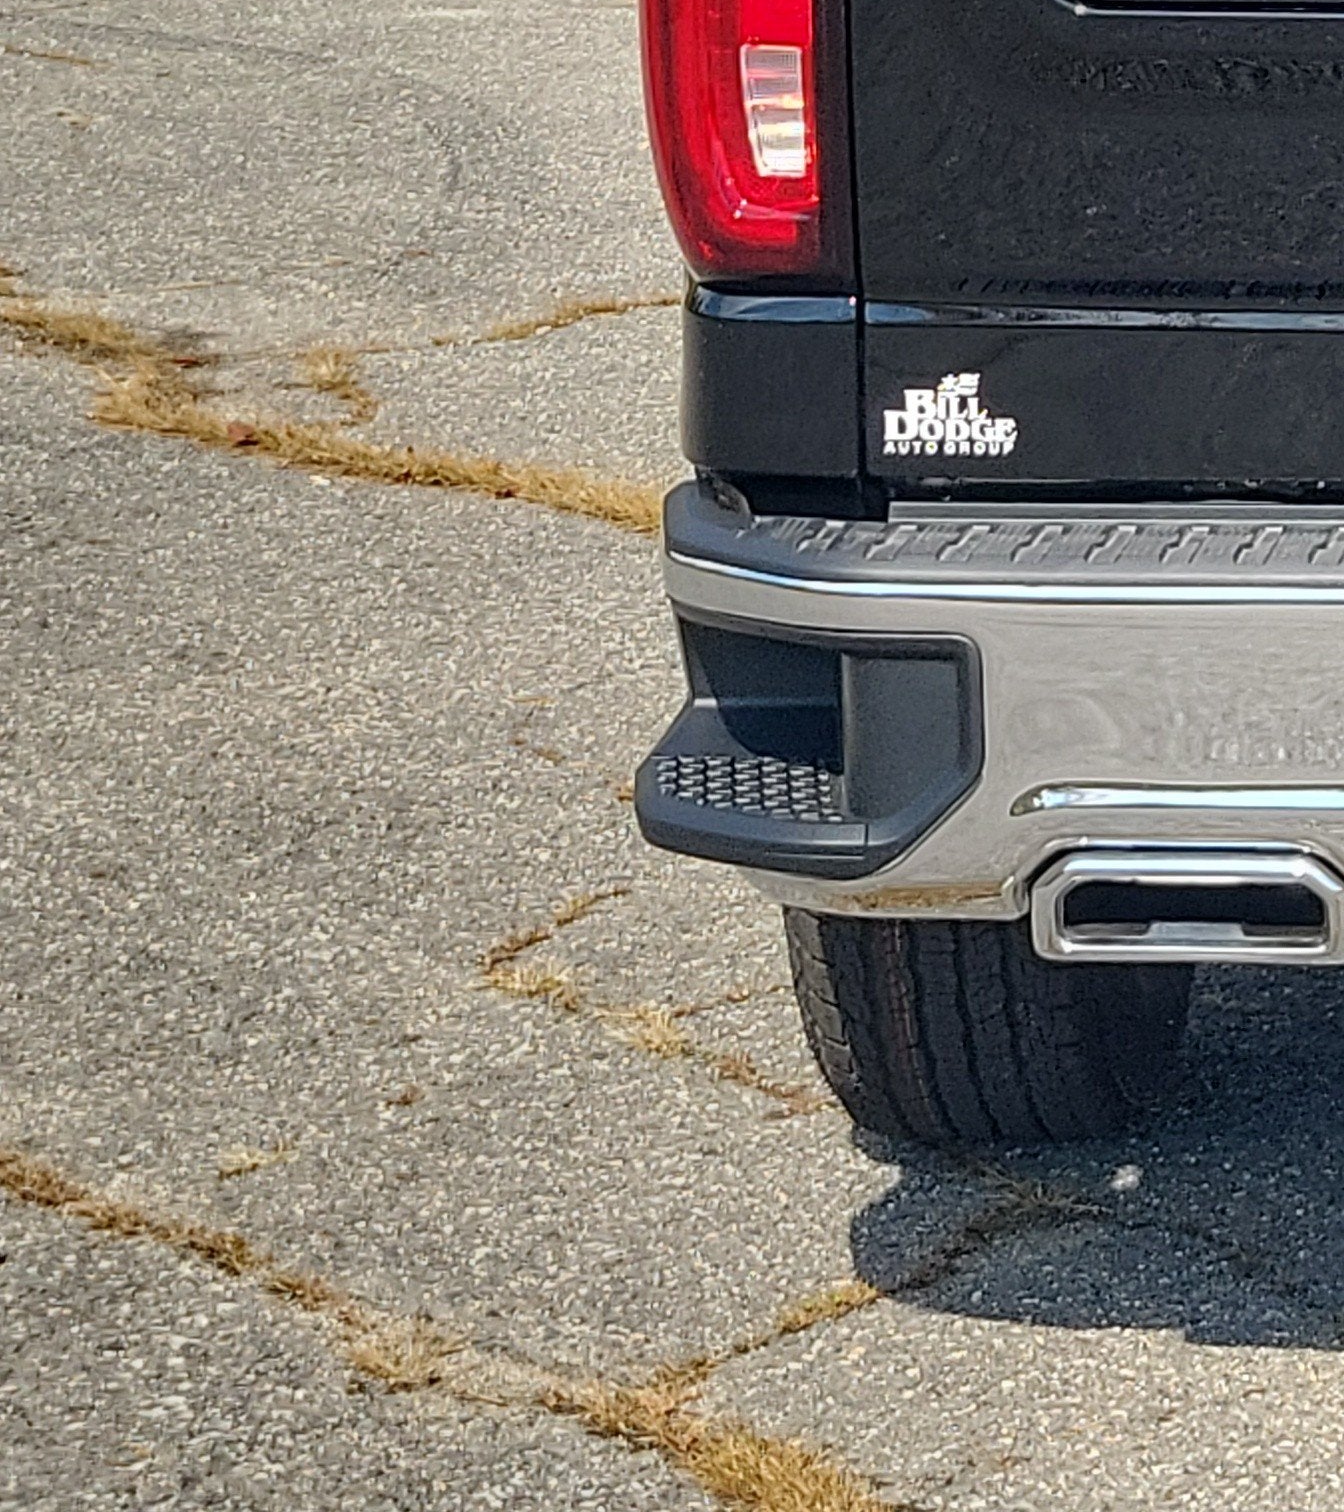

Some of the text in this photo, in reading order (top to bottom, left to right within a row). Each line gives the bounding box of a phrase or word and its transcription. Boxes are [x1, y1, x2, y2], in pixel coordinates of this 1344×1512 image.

[904, 389, 988, 420] BILL
[883, 410, 1018, 441] DODGE
[883, 441, 1015, 455] AUTO GROUP
